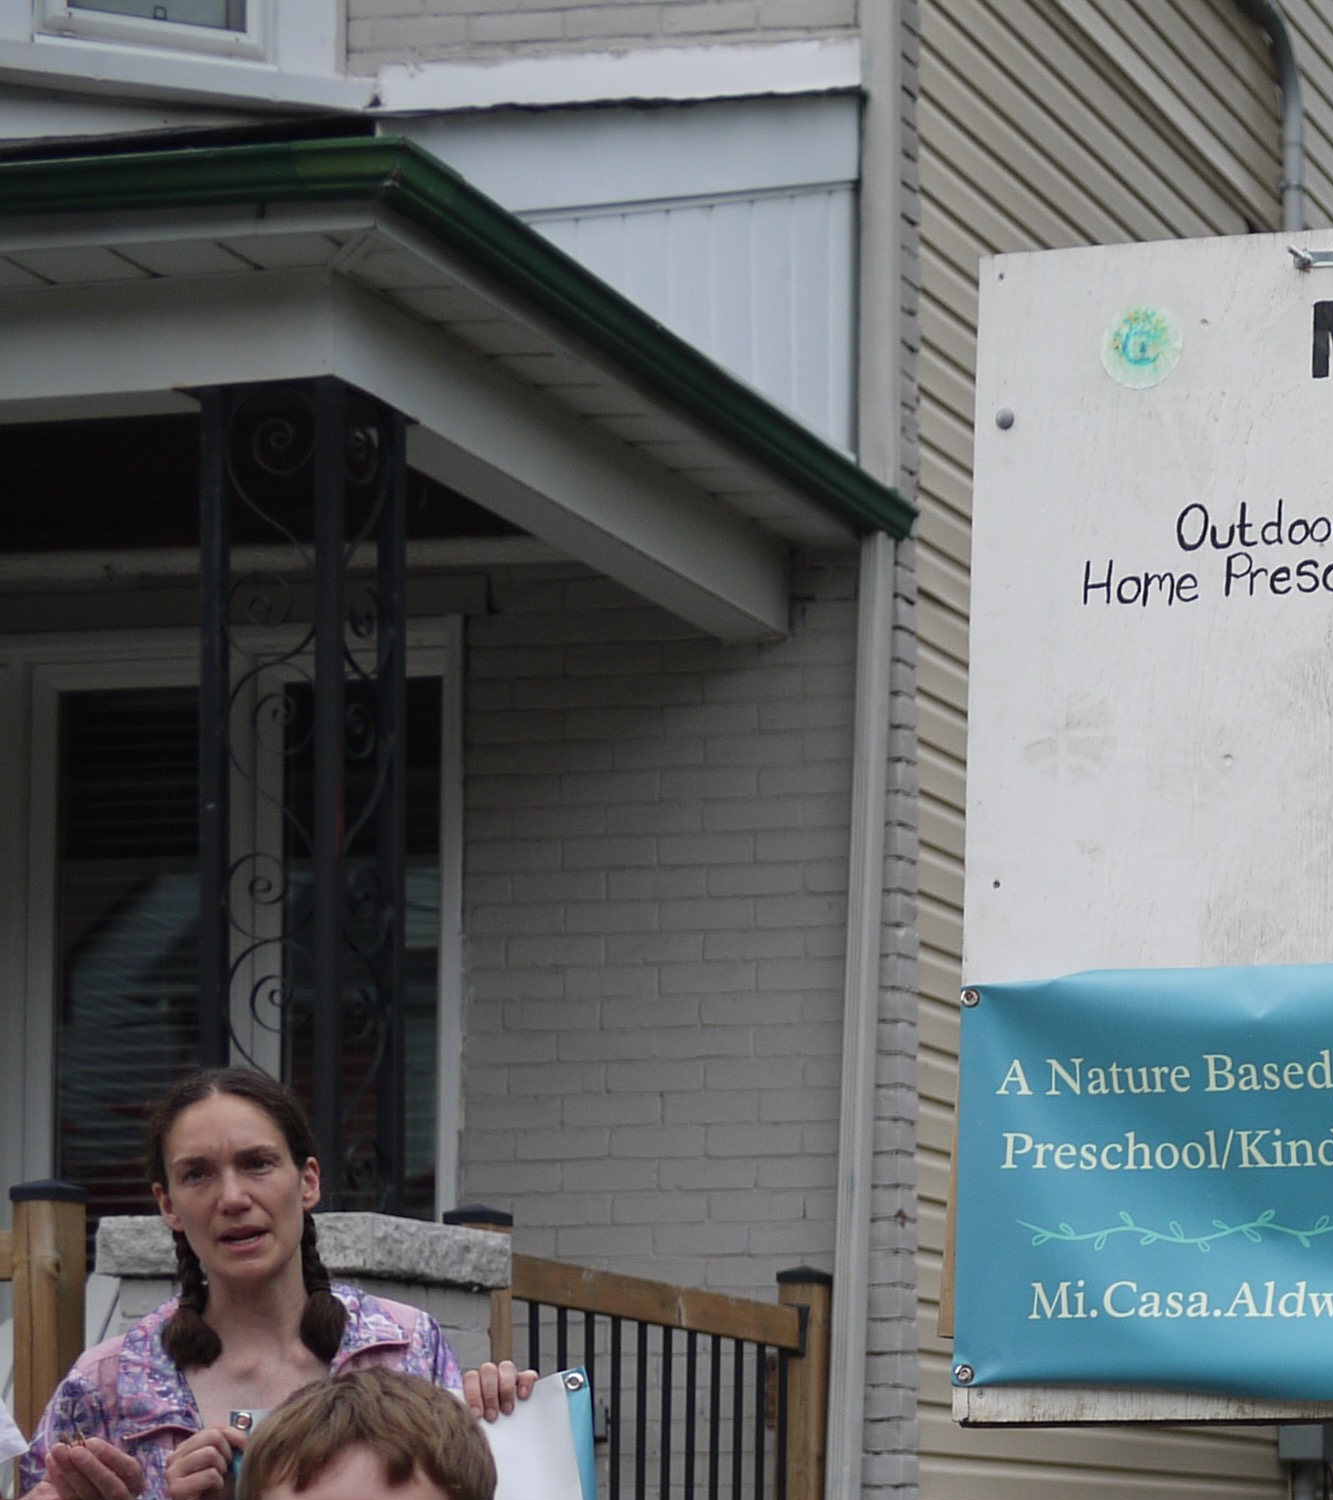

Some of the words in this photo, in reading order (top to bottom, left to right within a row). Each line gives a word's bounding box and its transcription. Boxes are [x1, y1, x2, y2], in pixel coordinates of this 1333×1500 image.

[1083, 559, 1199, 607] Home
[995, 1059, 1033, 1096] A
[1045, 1057, 1191, 1096] Nature
